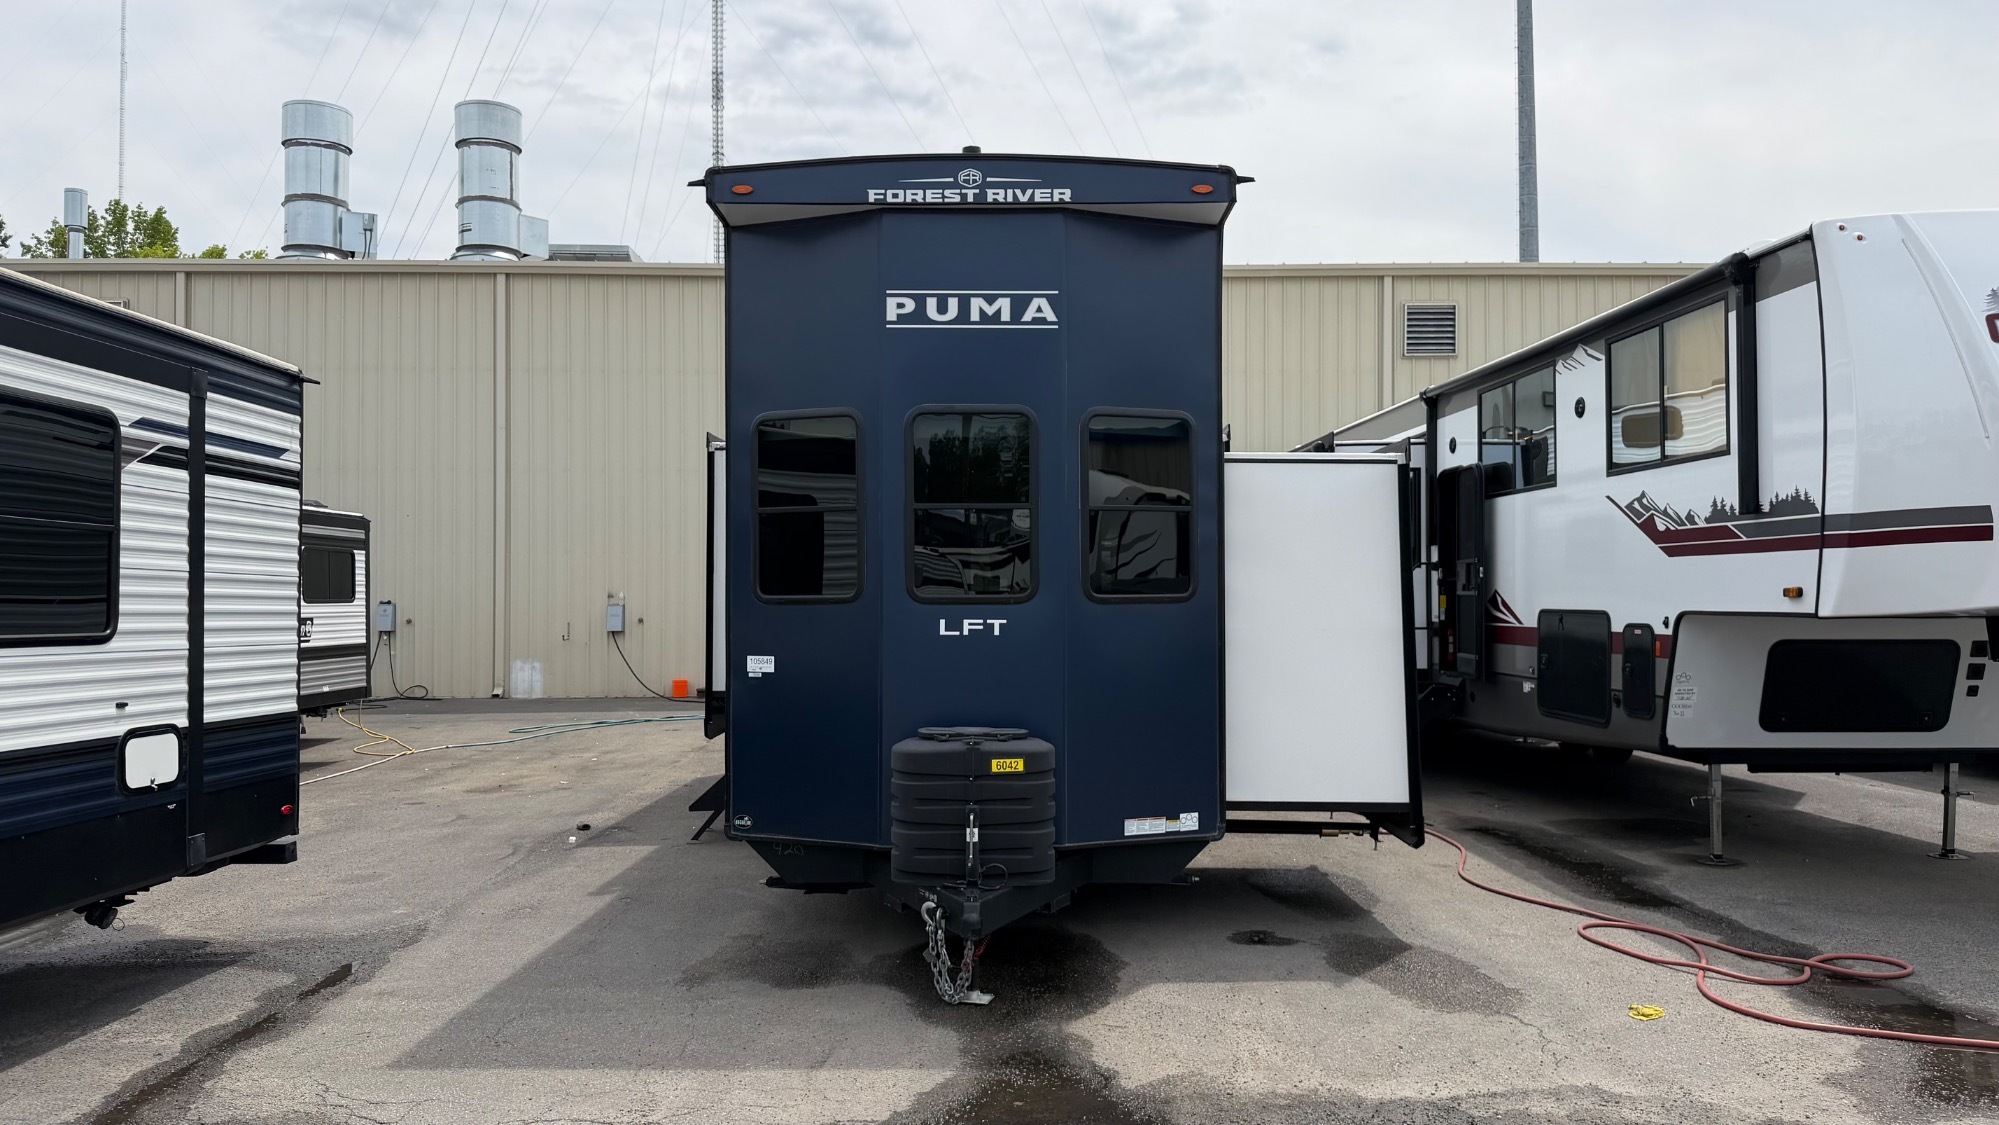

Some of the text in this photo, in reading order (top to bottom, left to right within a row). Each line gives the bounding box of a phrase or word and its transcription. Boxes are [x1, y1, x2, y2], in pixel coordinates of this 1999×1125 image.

[867, 188, 1072, 203] FOREST RIVER
[886, 297, 1059, 322] PUMA
[939, 618, 1007, 636] LFT
[996, 760, 1020, 771] 6042
